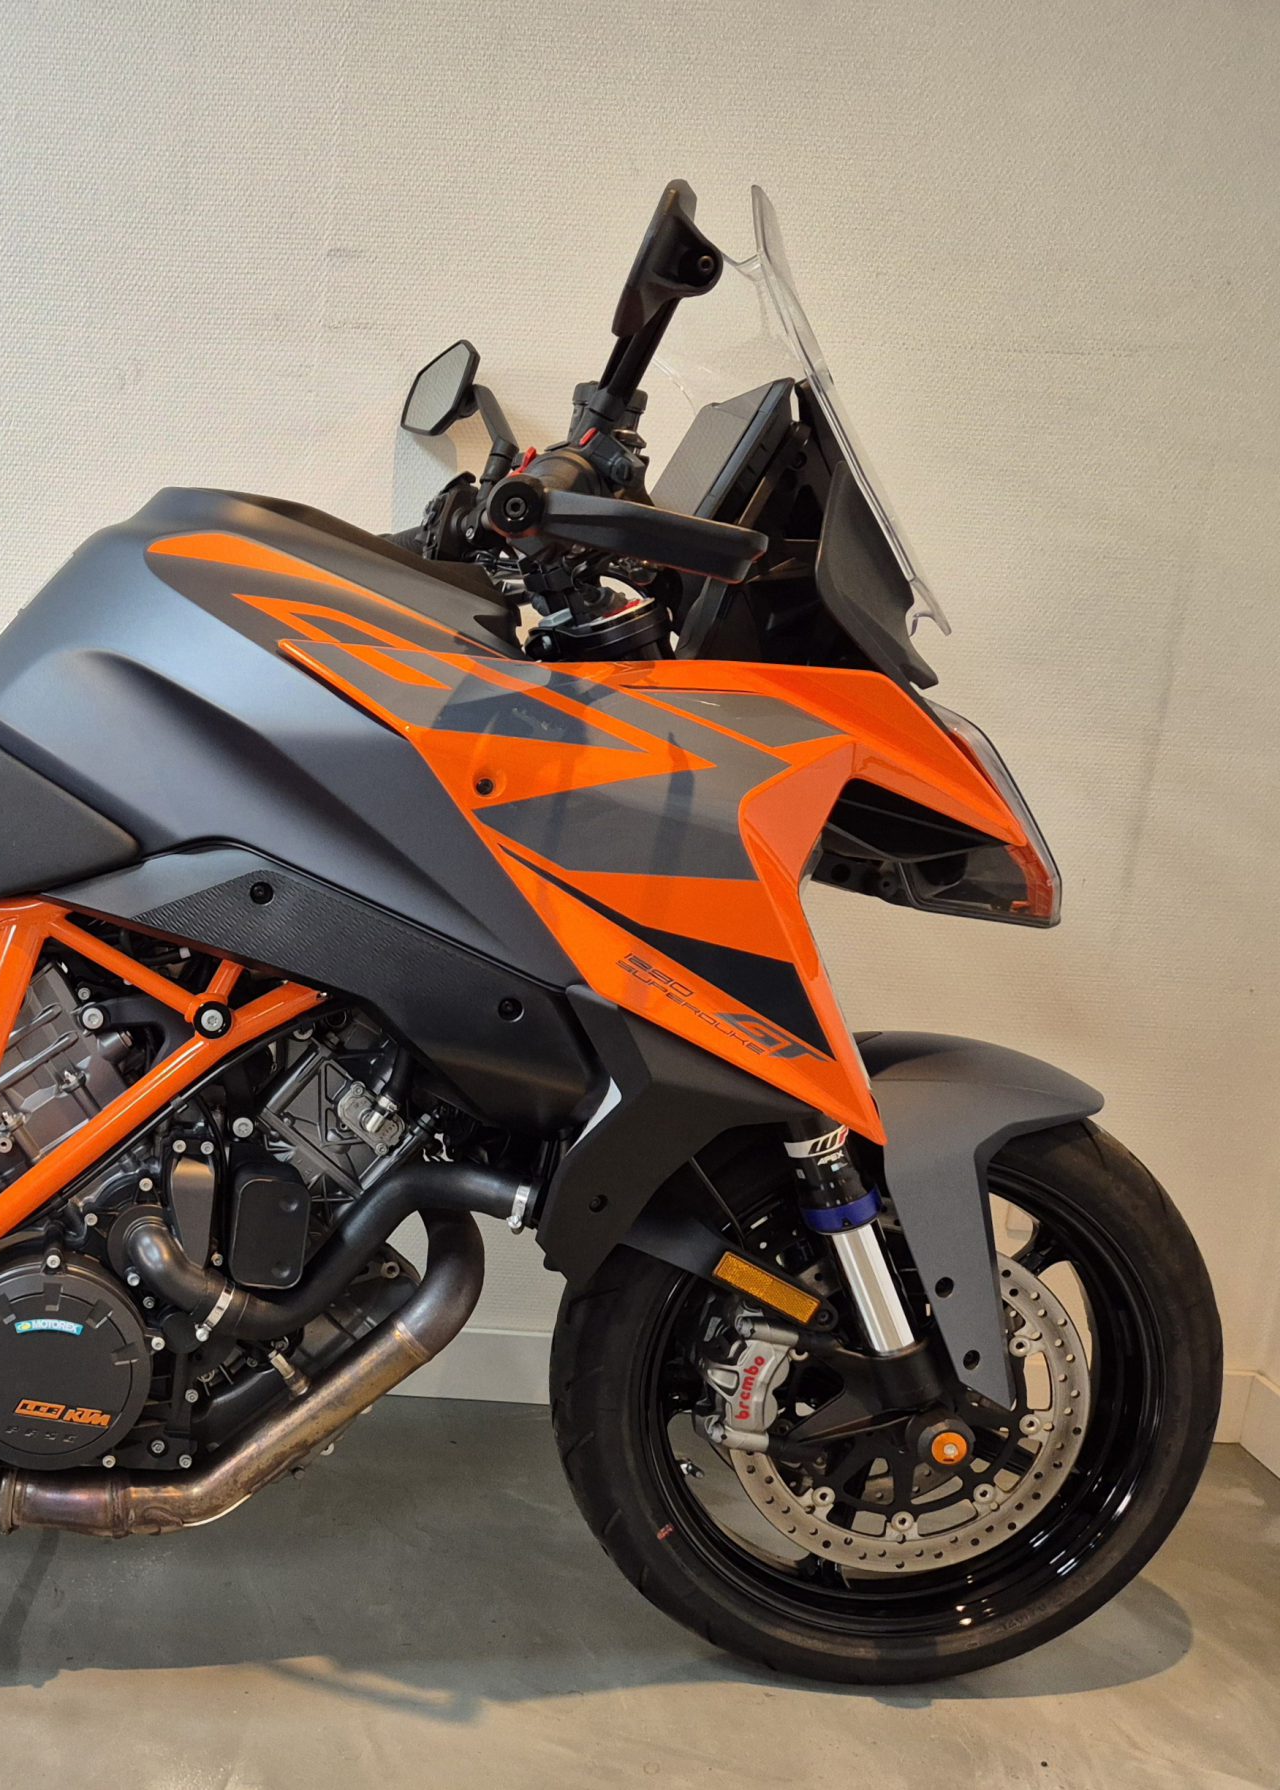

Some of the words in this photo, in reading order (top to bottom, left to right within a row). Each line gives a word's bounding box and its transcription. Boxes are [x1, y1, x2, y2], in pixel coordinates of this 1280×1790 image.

[714, 1012, 830, 1063] GT
[31, 1319, 79, 1334] MOTOREX
[734, 1355, 766, 1421] brembo
[63, 1407, 112, 1427] KTM
